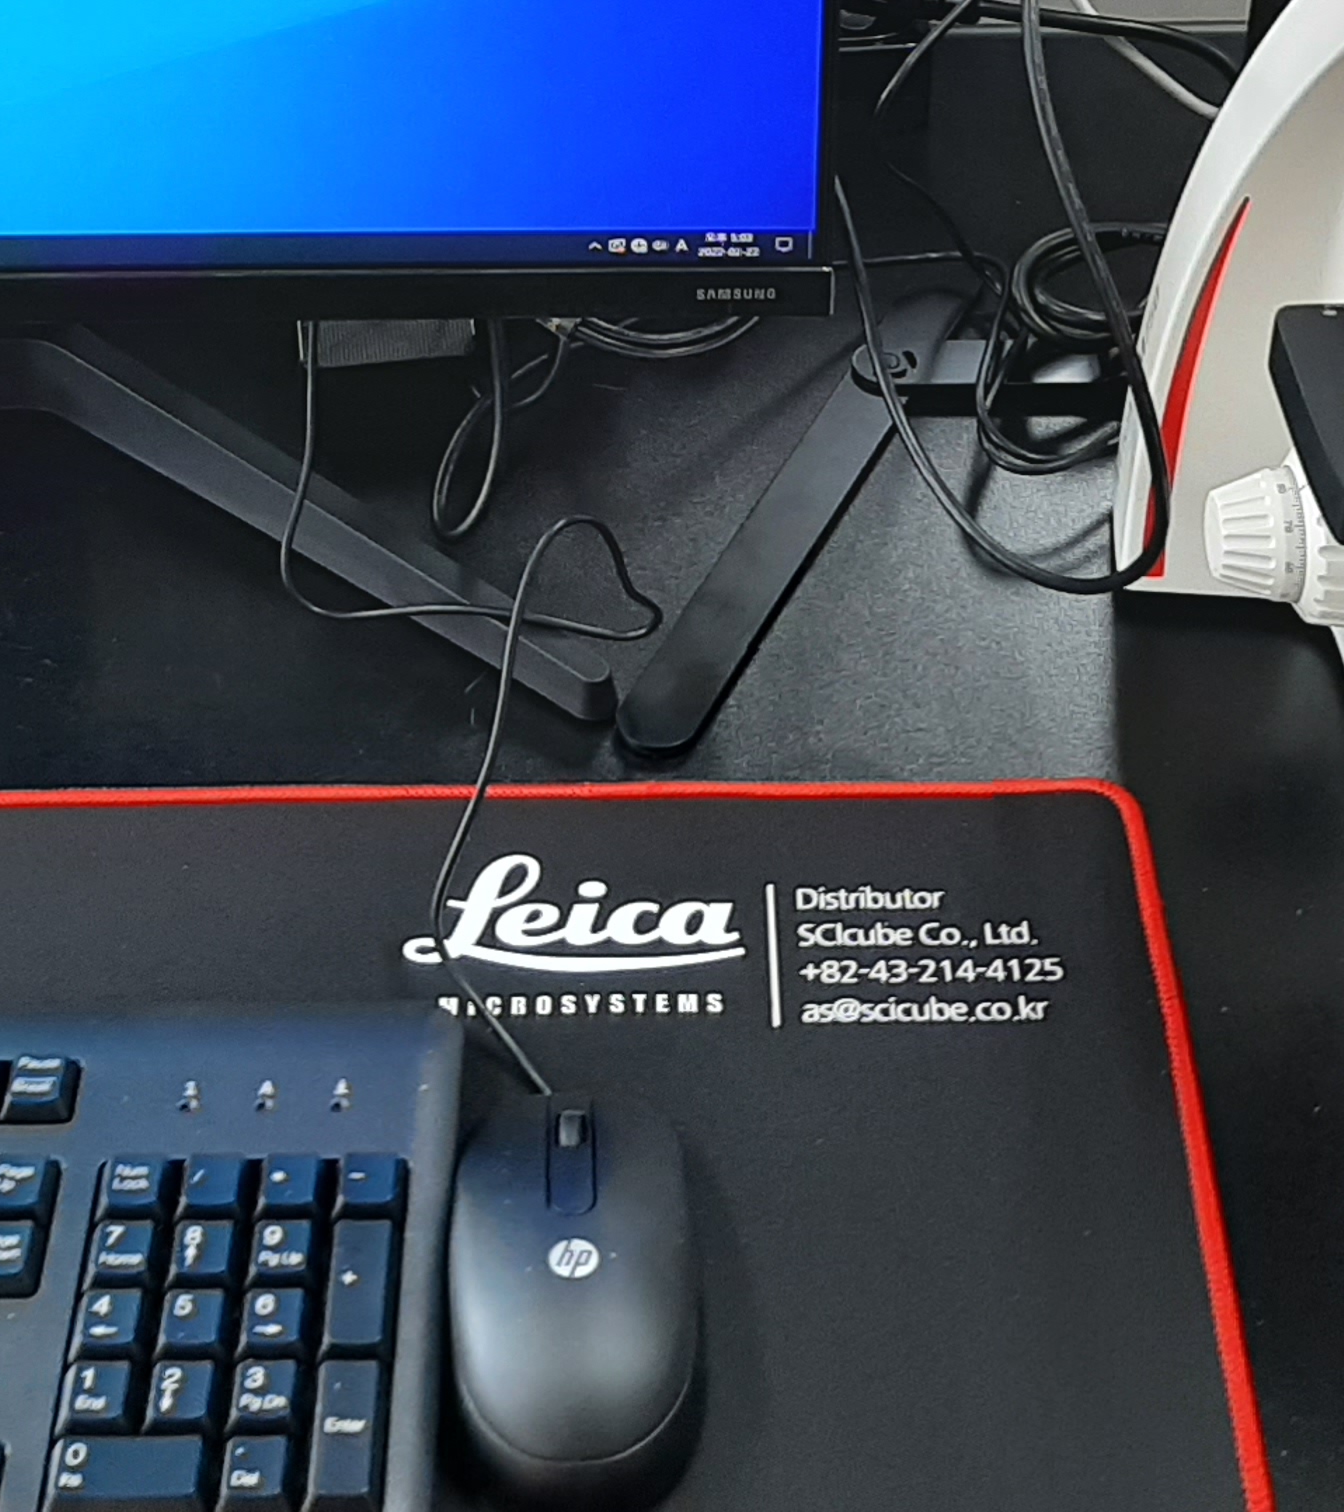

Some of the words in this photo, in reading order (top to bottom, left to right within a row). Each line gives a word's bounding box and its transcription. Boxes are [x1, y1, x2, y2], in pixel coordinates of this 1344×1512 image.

[696, 288, 776, 301] SAMSUNG
[795, 886, 945, 910] Distributor
[402, 854, 746, 972] Leica
[797, 922, 914, 948] SCIcube
[918, 922, 978, 949] Co.,
[983, 920, 1039, 946] Ltd.
[798, 957, 1064, 984] +82-43-214-4125
[802, 995, 1049, 1023] as@scicube.co.kr
[106, 1225, 126, 1247] 7
[184, 1225, 204, 1246] 8
[262, 1225, 284, 1247] 9
[548, 1237, 600, 1278] hp
[89, 1294, 112, 1316] 4
[173, 1293, 194, 1317] 5
[255, 1293, 276, 1316] 6
[81, 1367, 96, 1390] 1
[161, 1367, 183, 1390] 2
[243, 1366, 266, 1389] 3
[65, 1442, 88, 1467] 0
